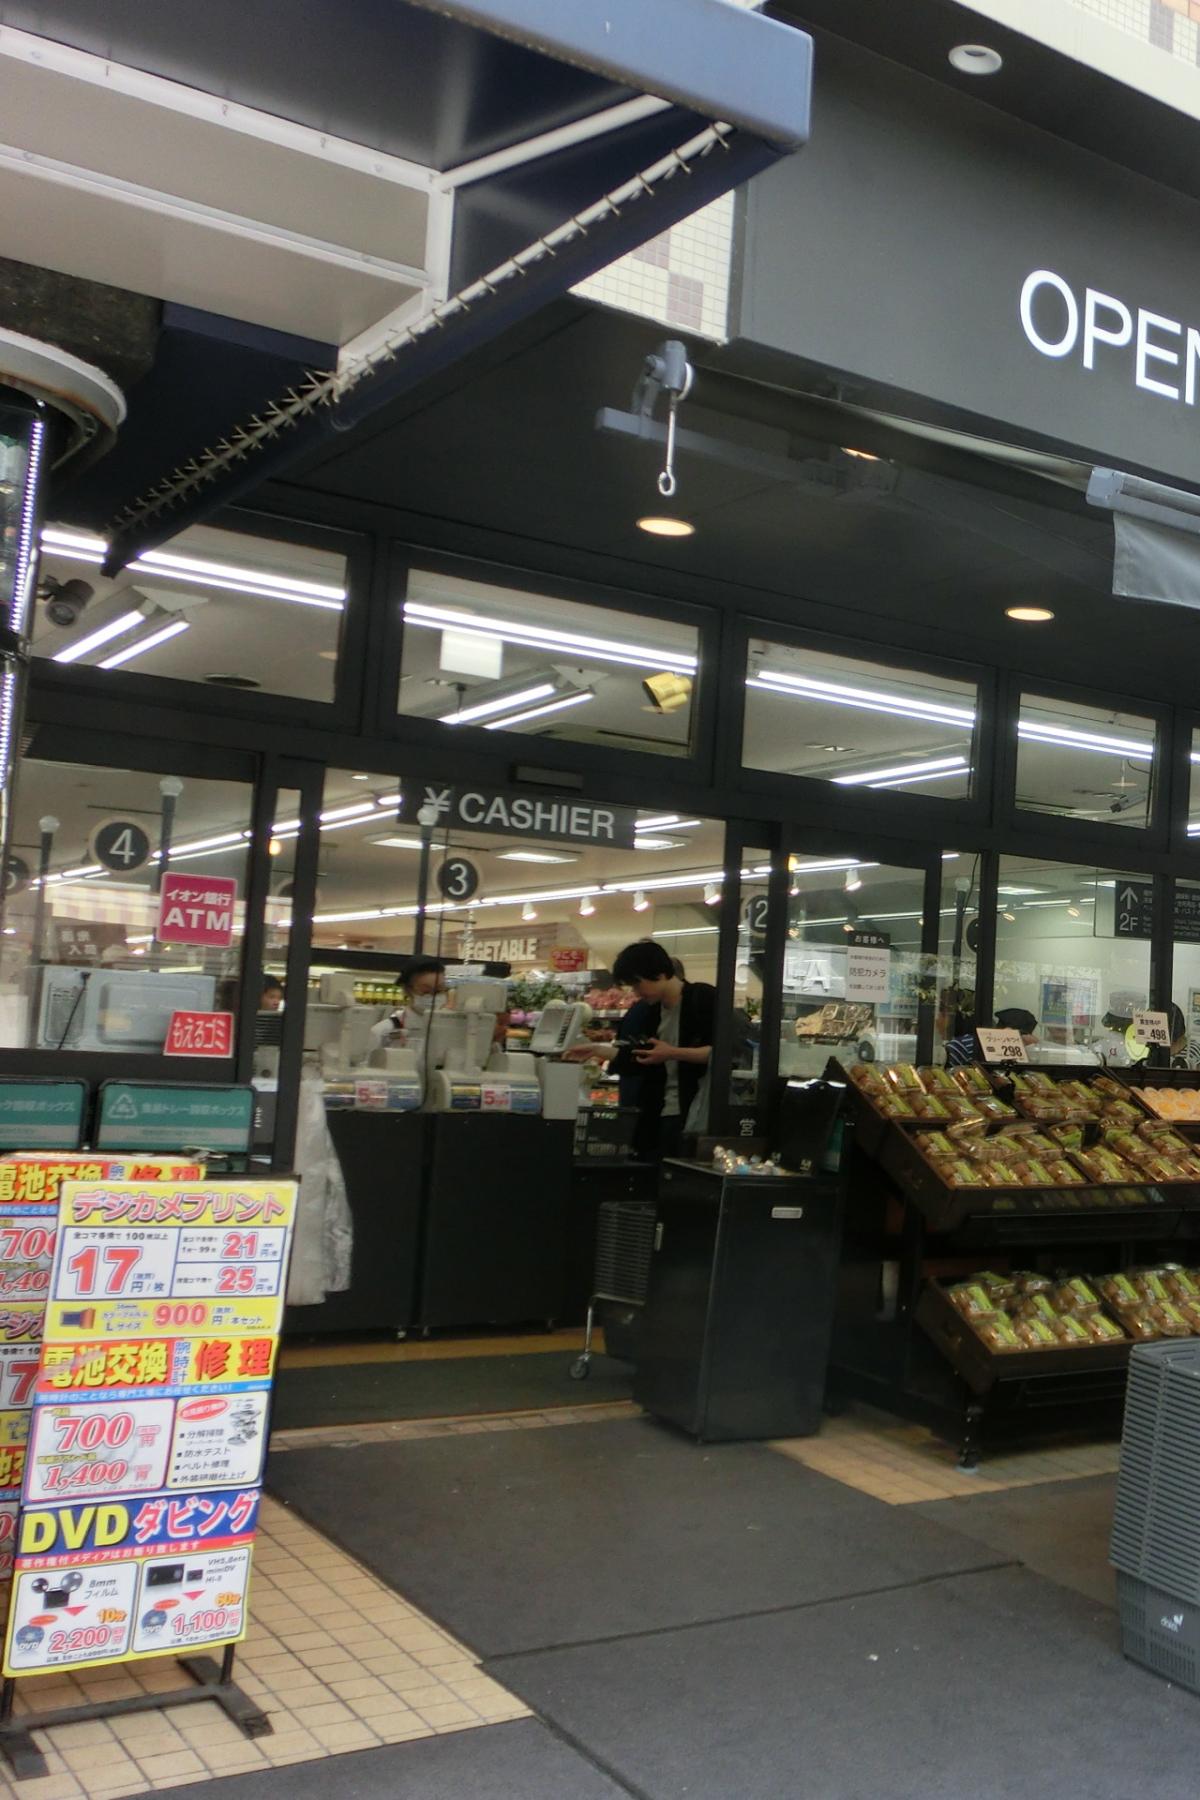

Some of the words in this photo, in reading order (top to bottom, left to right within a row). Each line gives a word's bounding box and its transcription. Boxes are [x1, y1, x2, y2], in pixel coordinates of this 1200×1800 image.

[458, 793, 615, 839] CASHIER
[110, 829, 135, 863] 4
[449, 863, 467, 895] 3
[166, 889, 231, 907] イオン銀行
[164, 908, 230, 931] ATM
[754, 900, 769, 928] 2
[1119, 913, 1139, 931] 2F
[458, 938, 537, 961] VEGETABLE
[173, 1018, 225, 1049] もえるゴミ
[1150, 1029, 1167, 1040] 498
[1001, 1045, 1023, 1057] 298
[73, 1191, 285, 1222] デジカメプリント
[220, 1231, 259, 1259] 21
[67, 1245, 143, 1295] 17
[215, 1266, 256, 1293] 25
[154, 1301, 208, 1328] 900
[43, 1341, 168, 1388] 電池交換
[194, 1338, 273, 1381] 修理
[54, 1411, 135, 1452] 700
[42, 1459, 128, 1491] 1,400
[20, 1504, 129, 1554] DVD
[134, 1490, 259, 1543] ダビング
[171, 1608, 227, 1635] 1,100
[48, 1625, 110, 1653] 2,200
